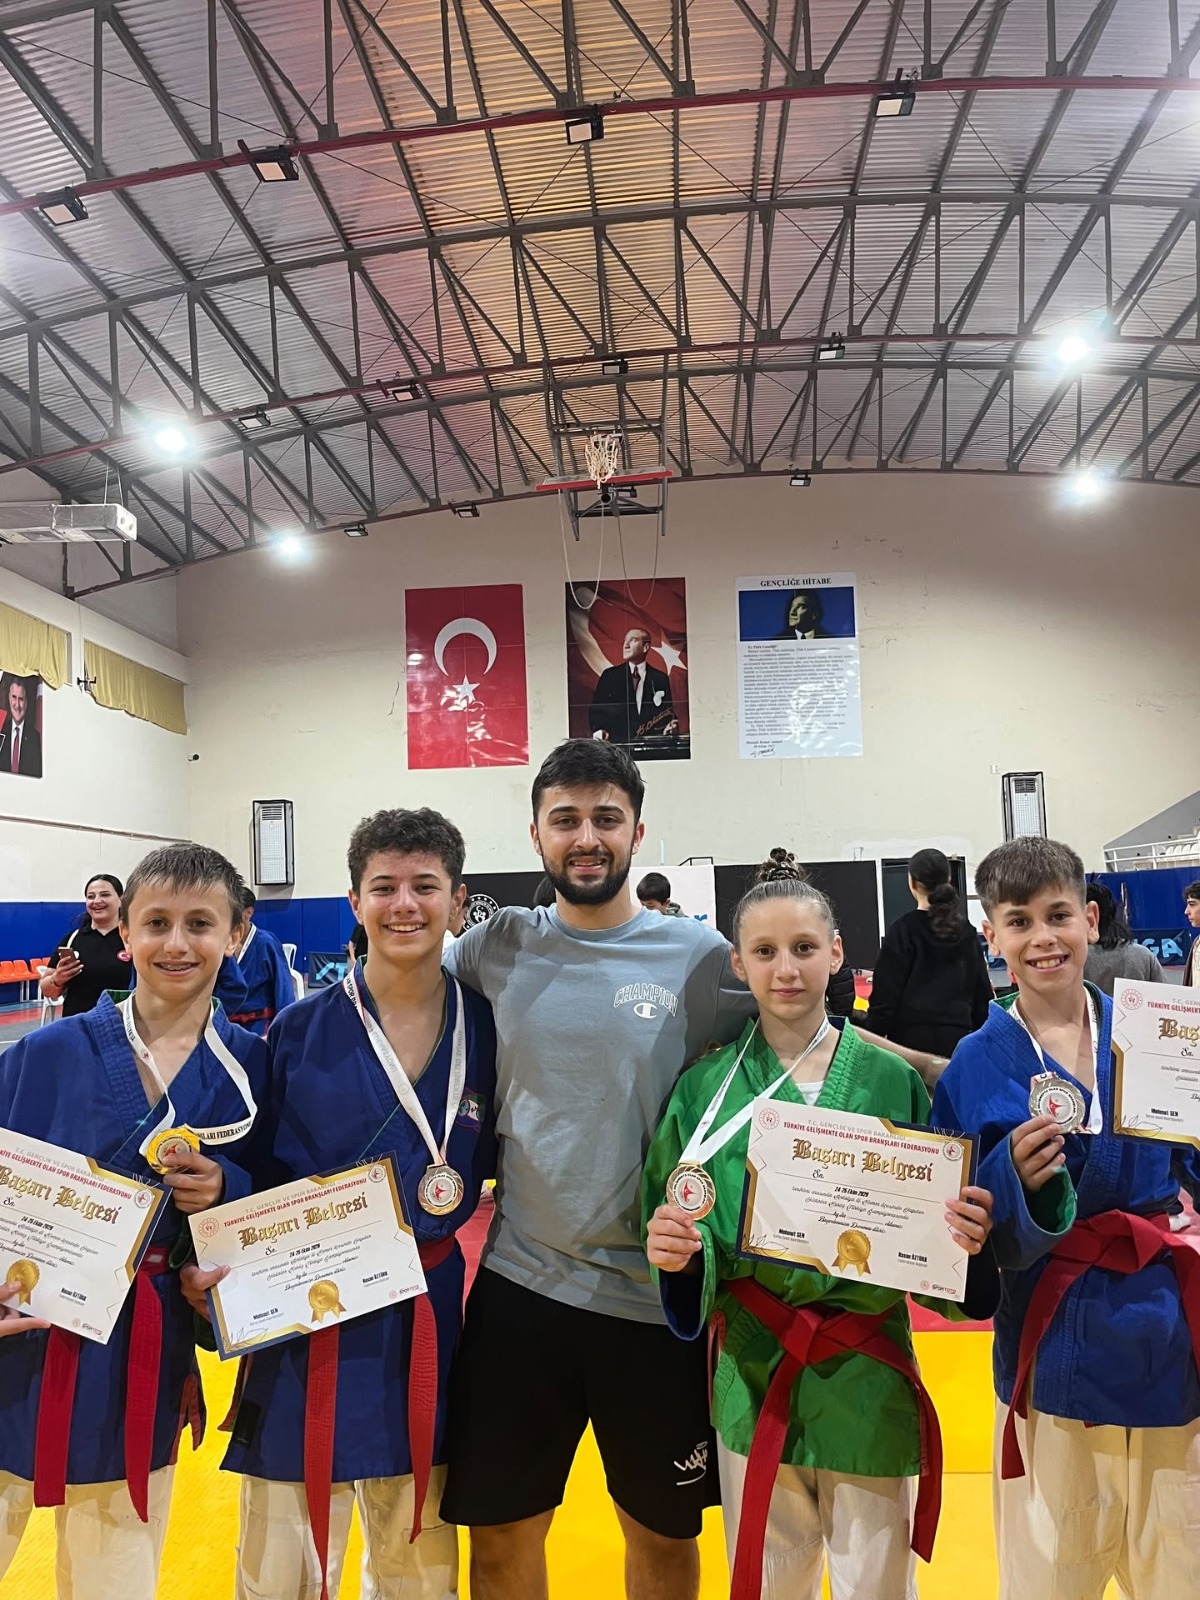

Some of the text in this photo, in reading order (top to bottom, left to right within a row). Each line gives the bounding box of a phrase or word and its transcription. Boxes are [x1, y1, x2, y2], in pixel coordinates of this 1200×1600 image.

[760, 577, 832, 588] GENÇLİĞE HİTABE
[614, 983, 679, 1017] CHAMPION
[1148, 1002, 1170, 1010] TÜRKİYE
[1159, 1018, 1200, 1047] Baş
[784, 1122, 805, 1131] TÜRKİYE
[806, 1126, 838, 1136] GELİŞMEKTE
[869, 1137, 899, 1147] BRANŞLARI
[901, 1143, 939, 1154] FEDERASYONU
[822, 1122, 846, 1130] GENÇLİK
[12, 1154, 42, 1168] GELİŞMEKTE
[42, 1164, 56, 1172] OLAN
[56, 1169, 70, 1177] SPOR
[70, 1174, 97, 1187] BRANŞLARI
[98, 1183, 132, 1199] FEDERASYONU
[793, 1139, 932, 1181] Başarı Belgesi
[53, 1186, 121, 1223] Belgesi
[224, 1178, 366, 1227] TÜRKİYE GELİŞMEKTE OLAN SPOR BRANŞLARI FEDERASYONU
[238, 1218, 299, 1250] Başarı
[303, 1192, 367, 1229] Belgesi
